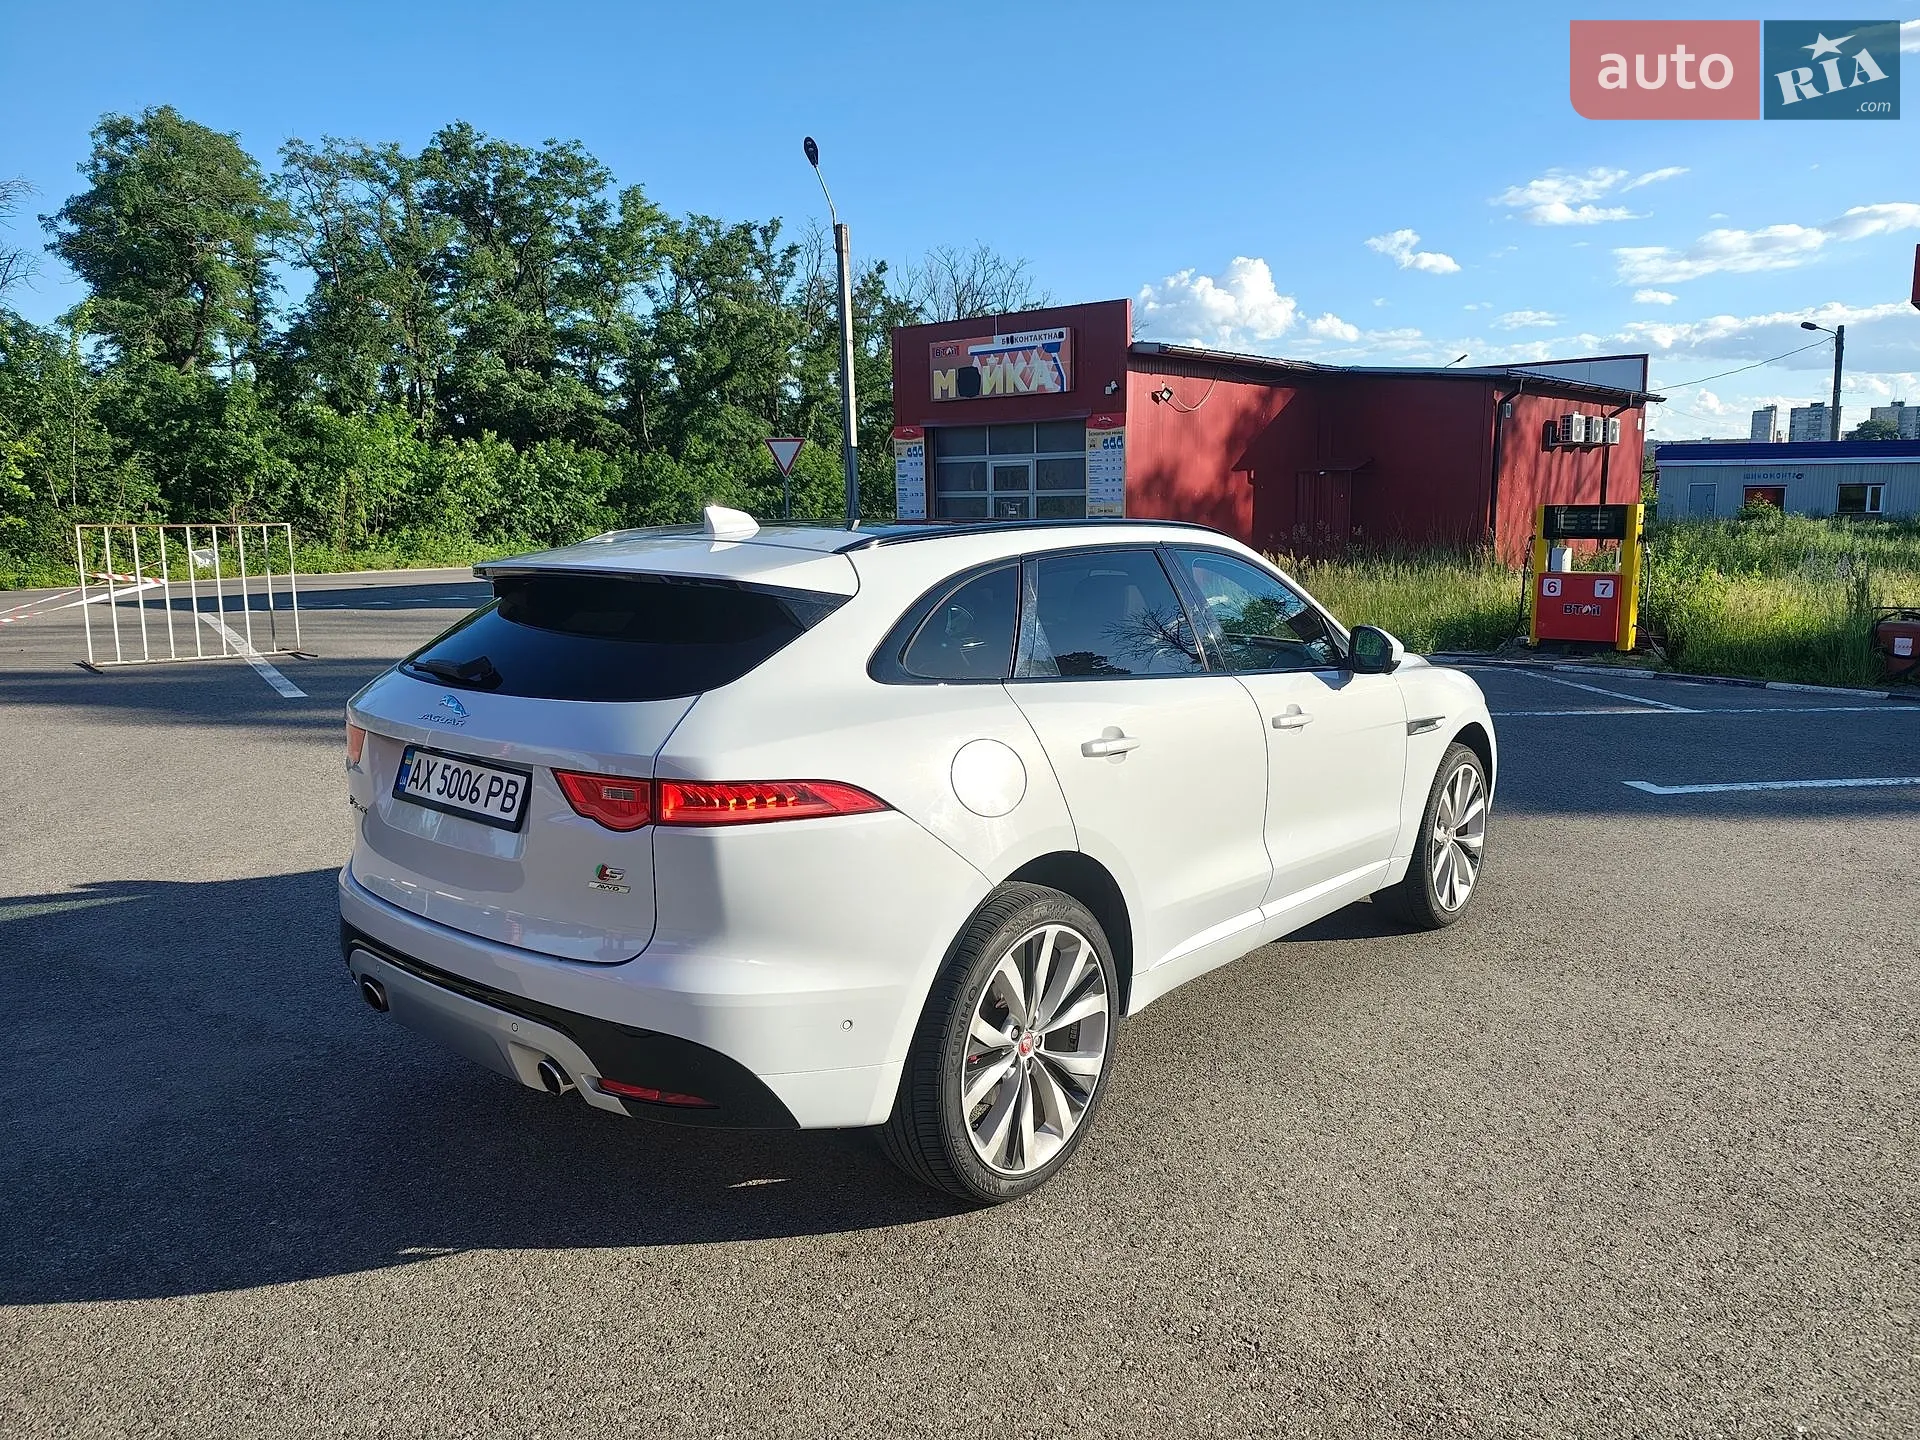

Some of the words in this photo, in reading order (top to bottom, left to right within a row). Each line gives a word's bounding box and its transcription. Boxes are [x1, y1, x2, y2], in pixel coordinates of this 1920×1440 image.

[1001, 331, 1065, 345] БКОНТАКТНА
[933, 355, 1062, 400] МЙКА
[1743, 472, 1805, 481] ШИНОМОНТ
[1547, 581, 1557, 594] 6
[1599, 583, 1610, 595] 7
[418, 713, 466, 728] JAGUAR
[408, 758, 438, 793] AX
[436, 763, 485, 804] 5006
[484, 775, 519, 813] PB
